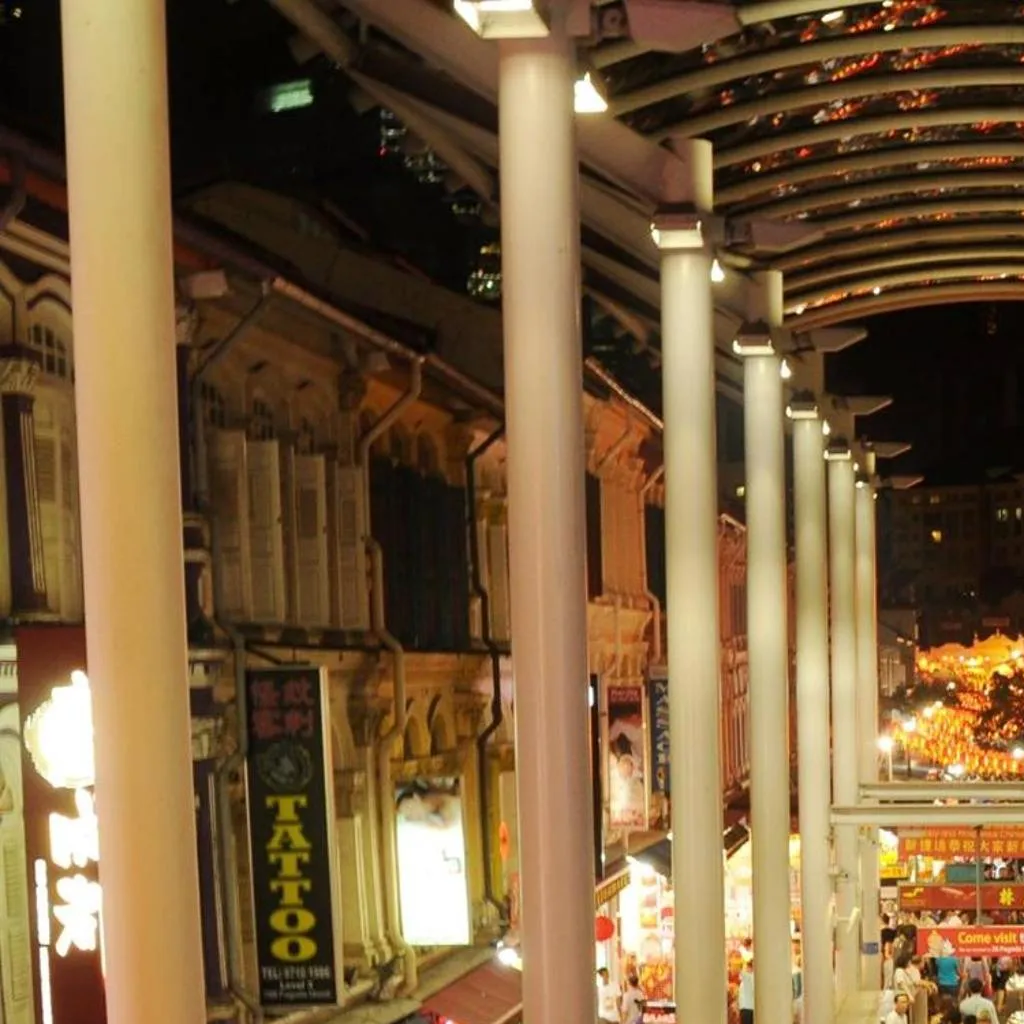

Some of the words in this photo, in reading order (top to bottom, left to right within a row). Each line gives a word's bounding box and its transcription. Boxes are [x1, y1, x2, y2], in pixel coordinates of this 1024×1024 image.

[266, 796, 318, 962] TATTOO
[958, 931, 991, 944] Come
[993, 931, 1017, 944] visit
